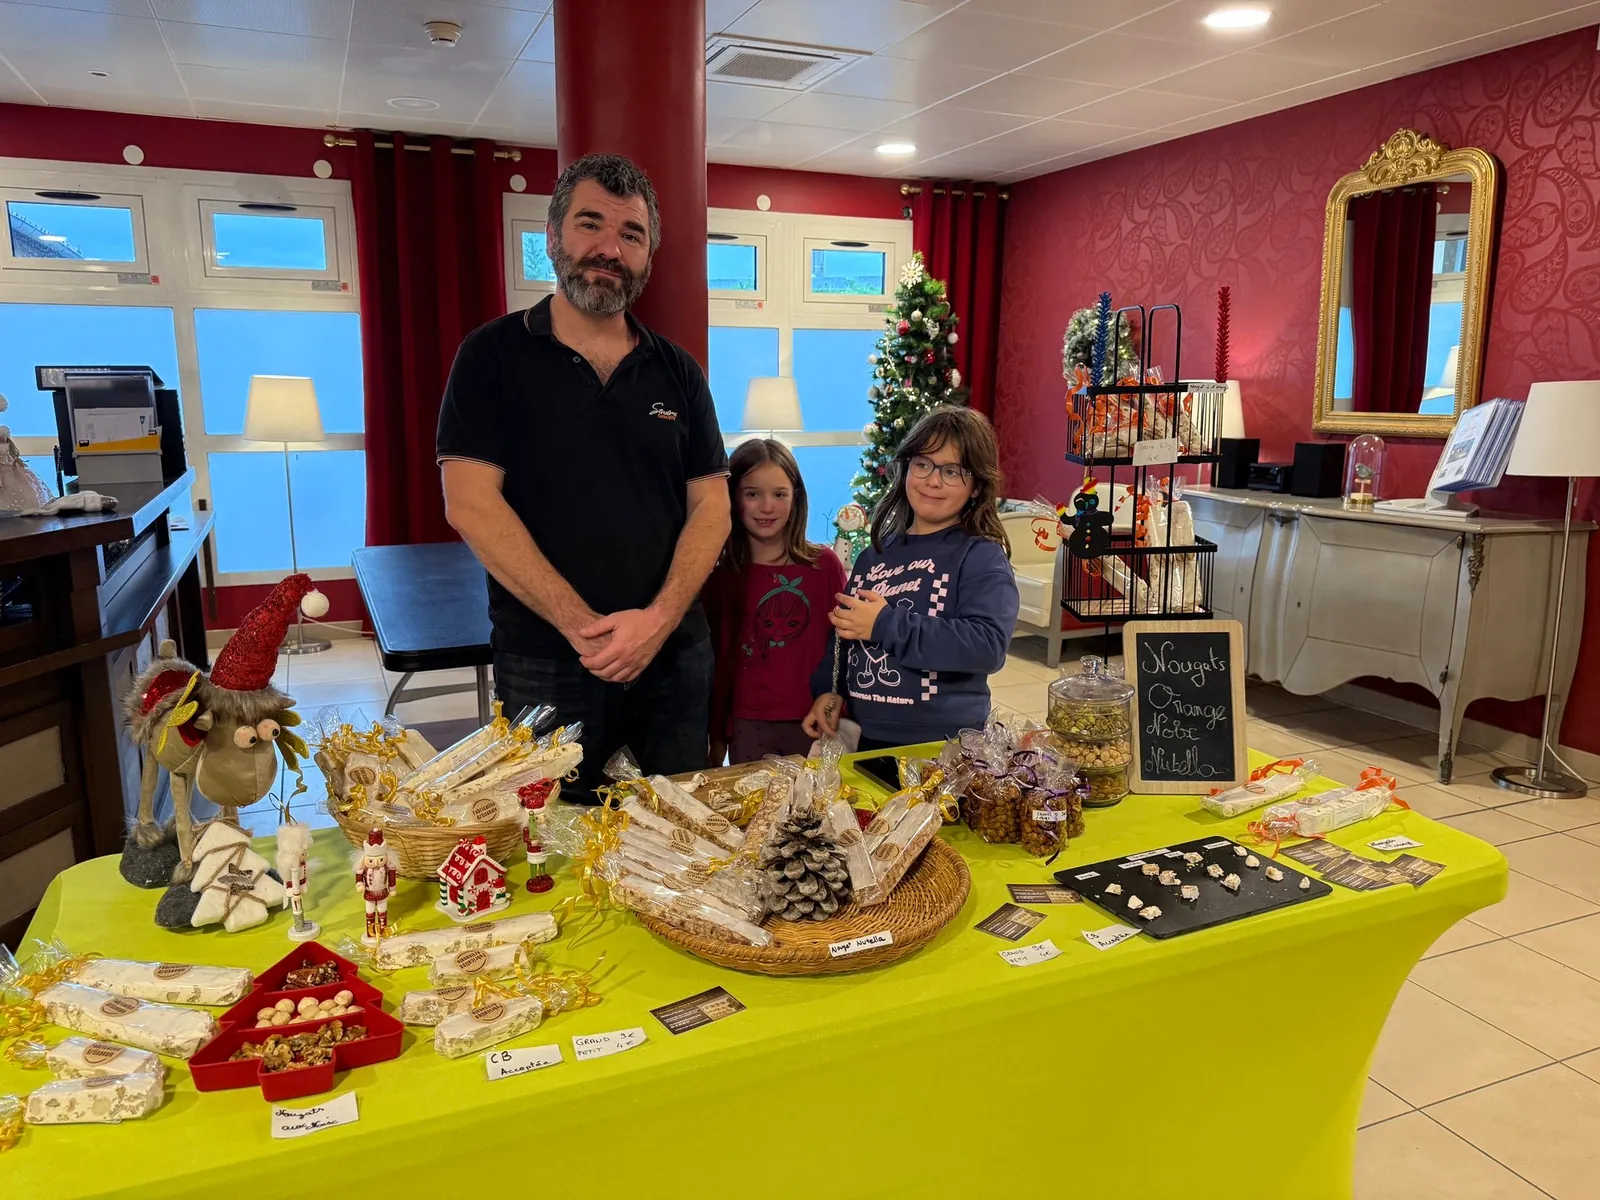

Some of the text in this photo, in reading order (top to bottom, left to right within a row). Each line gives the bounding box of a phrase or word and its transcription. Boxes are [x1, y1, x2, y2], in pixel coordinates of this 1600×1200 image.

[866, 558, 936, 582] Love our
[871, 577, 922, 597] Planet
[1142, 641, 1226, 688] Nougats
[1148, 683, 1227, 730] Orange
[1145, 745, 1230, 777] Nutella
[856, 936, 886, 946] Nutella
[576, 1036, 610, 1046] GRAND
[577, 1046, 602, 1056] PETIT
